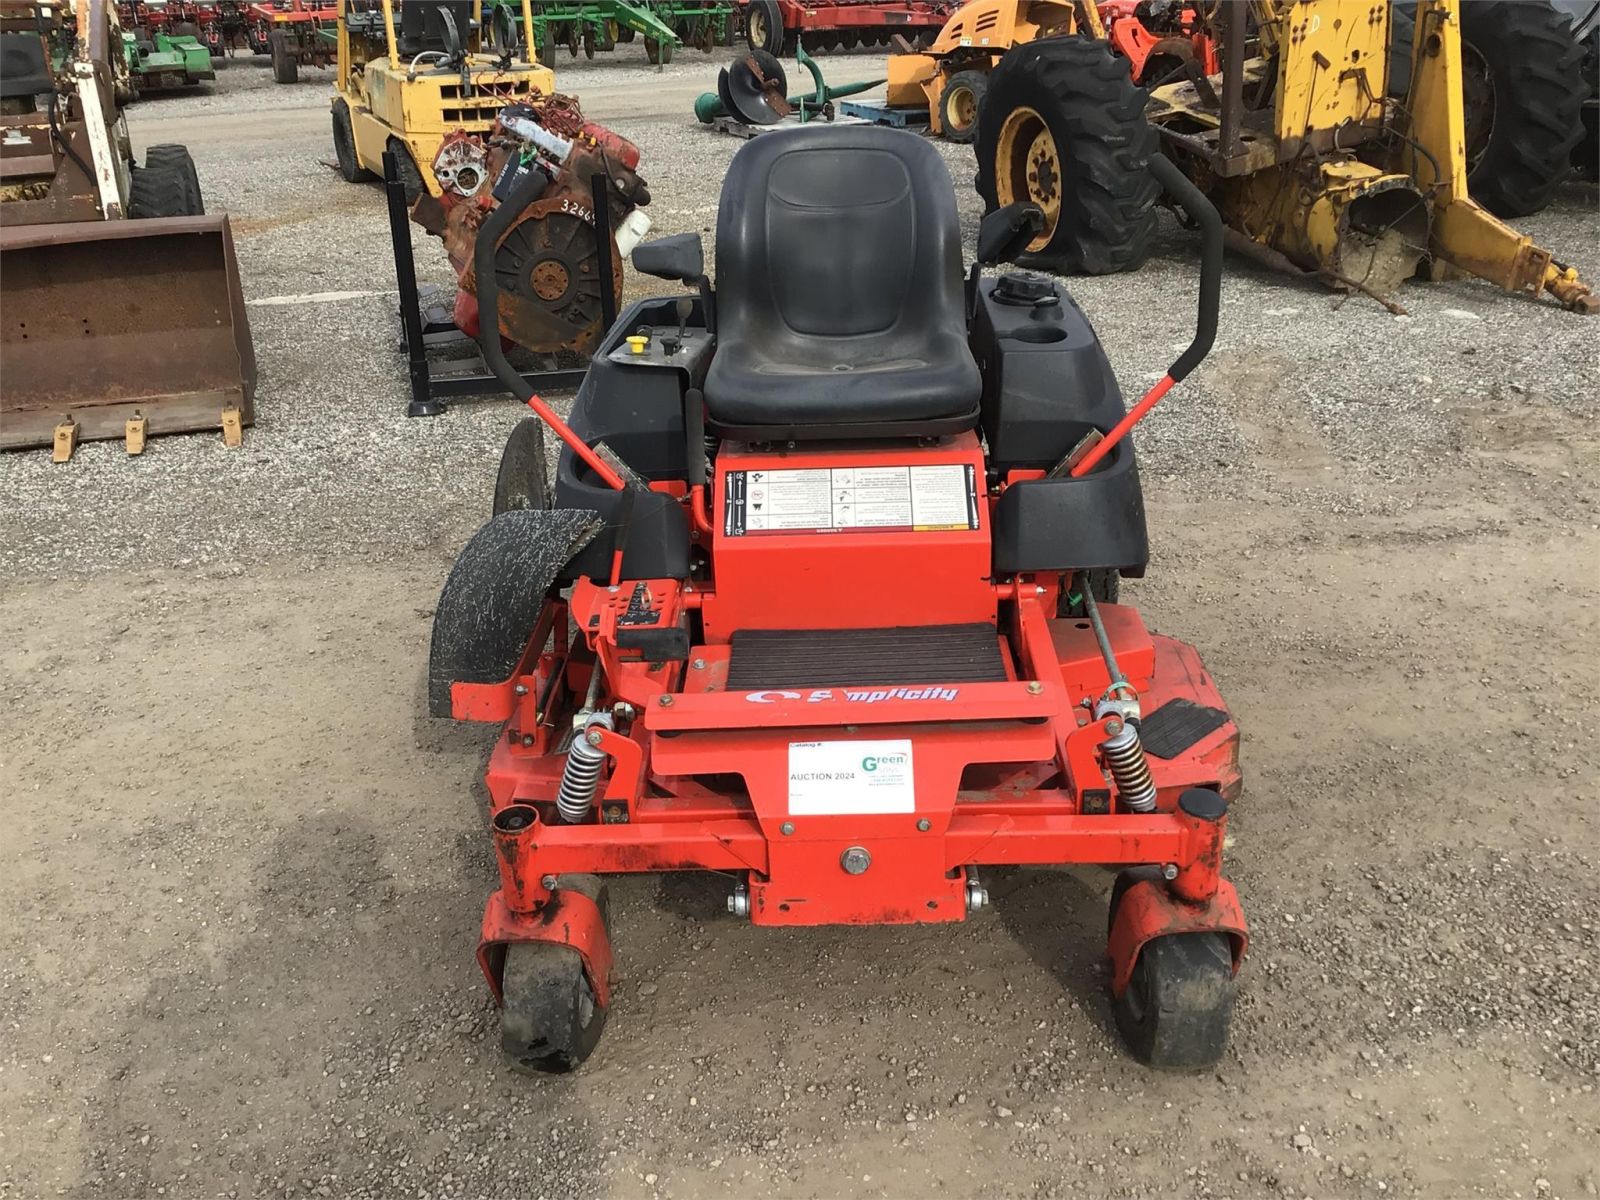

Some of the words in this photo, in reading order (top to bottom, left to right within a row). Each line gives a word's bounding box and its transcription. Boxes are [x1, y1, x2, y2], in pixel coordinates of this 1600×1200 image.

[560, 199, 596, 227] 3266
[806, 687, 960, 703] Smplicity
[862, 756, 904, 772] Green
[790, 773, 832, 781] AUCTION
